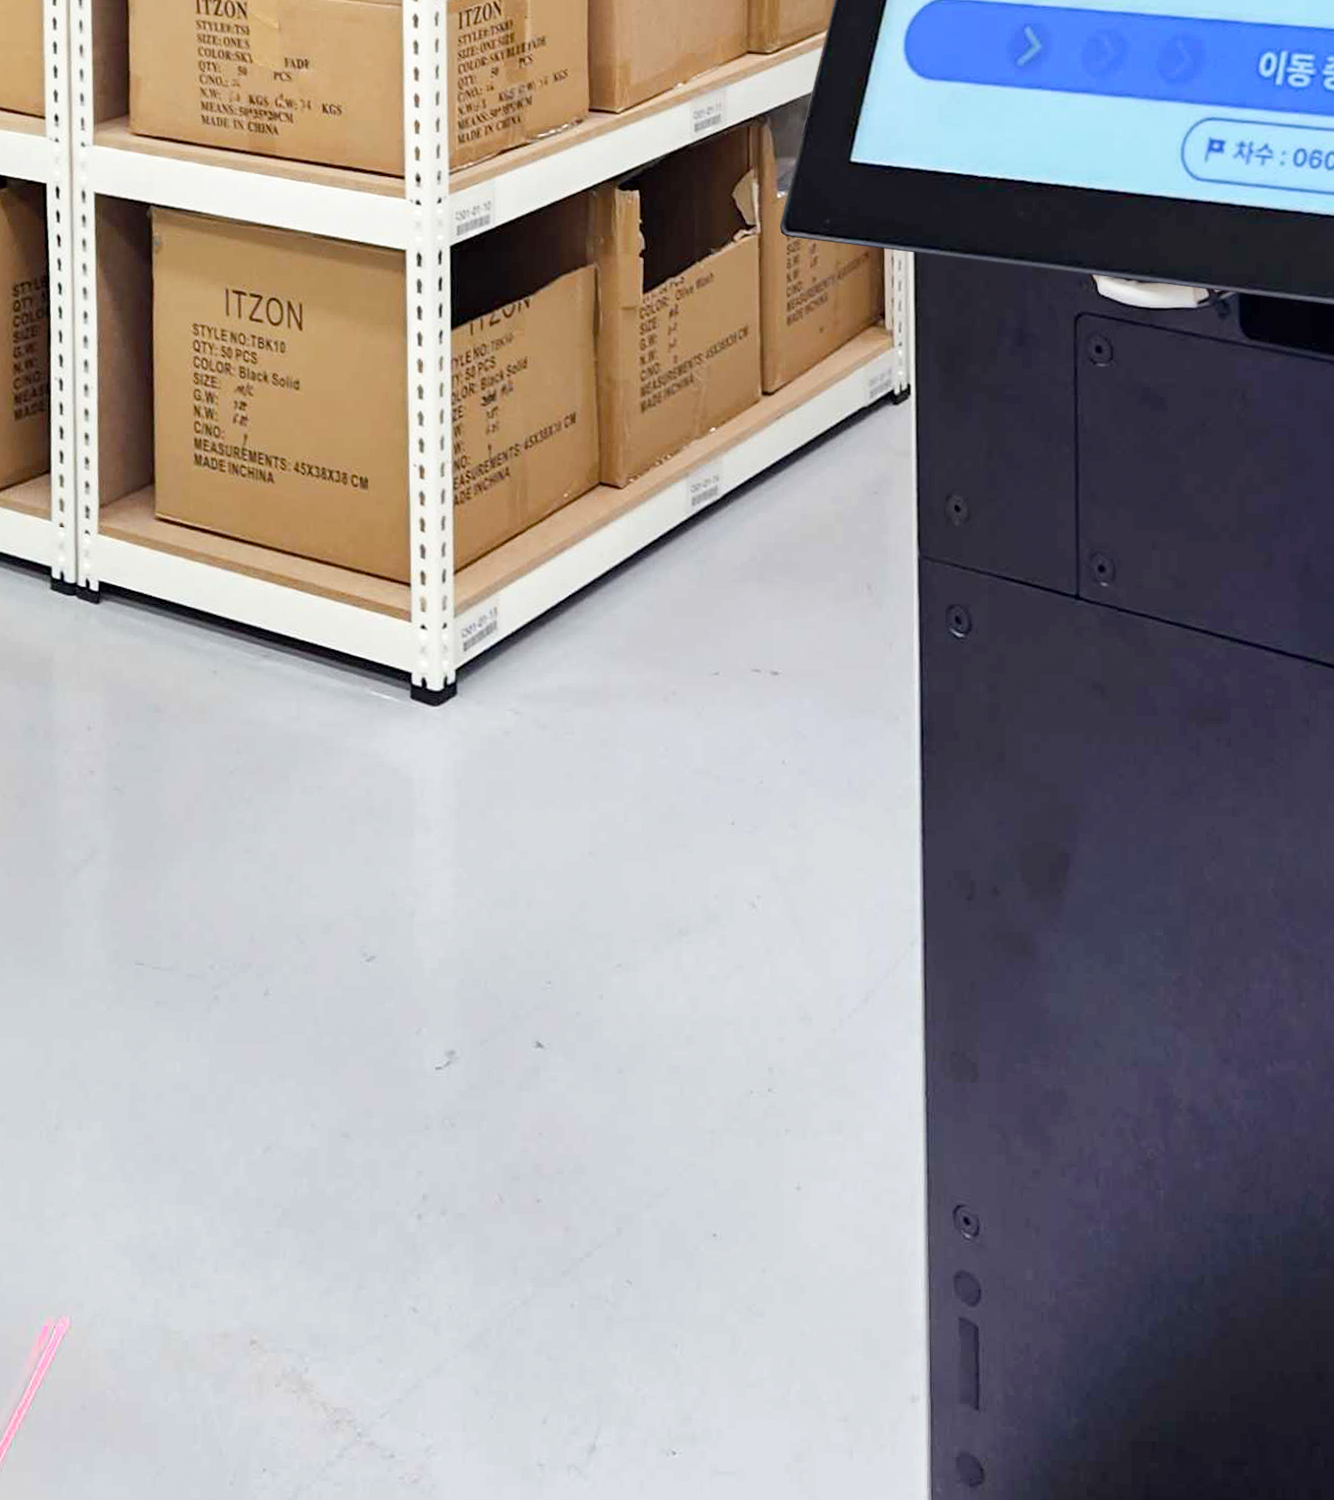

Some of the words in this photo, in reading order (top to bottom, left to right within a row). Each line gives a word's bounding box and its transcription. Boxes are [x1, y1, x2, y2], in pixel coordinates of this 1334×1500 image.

[458, 0, 503, 30] ITZON
[273, 71, 292, 82] PCS
[1258, 51, 1316, 88] 이동
[248, 94, 269, 106] KGS
[322, 103, 342, 116] KGS
[201, 115, 227, 128] MADE
[233, 119, 244, 130] IN
[247, 121, 279, 135] CHINA
[458, 130, 481, 144] MADE
[496, 115, 522, 131] CHINA
[1233, 140, 1274, 166] 차수
[225, 288, 303, 331] ITZON
[193, 323, 227, 342] STYLE
[193, 339, 218, 356] QTY:
[221, 346, 232, 359] 50
[235, 349, 258, 364] PCS
[193, 356, 235, 376] COLOR:
[239, 366, 268, 383] Black
[272, 373, 300, 390] Solid
[477, 356, 496, 375] PCS
[480, 371, 505, 390] Black
[506, 356, 528, 378] Solid
[193, 372, 220, 390] SIZE:
[194, 454, 226, 472] MADE
[194, 438, 292, 472] MEASUREMENTS:
[351, 474, 369, 489] CM
[453, 443, 521, 490] EASUREMENTS:
[564, 411, 577, 429] CM
